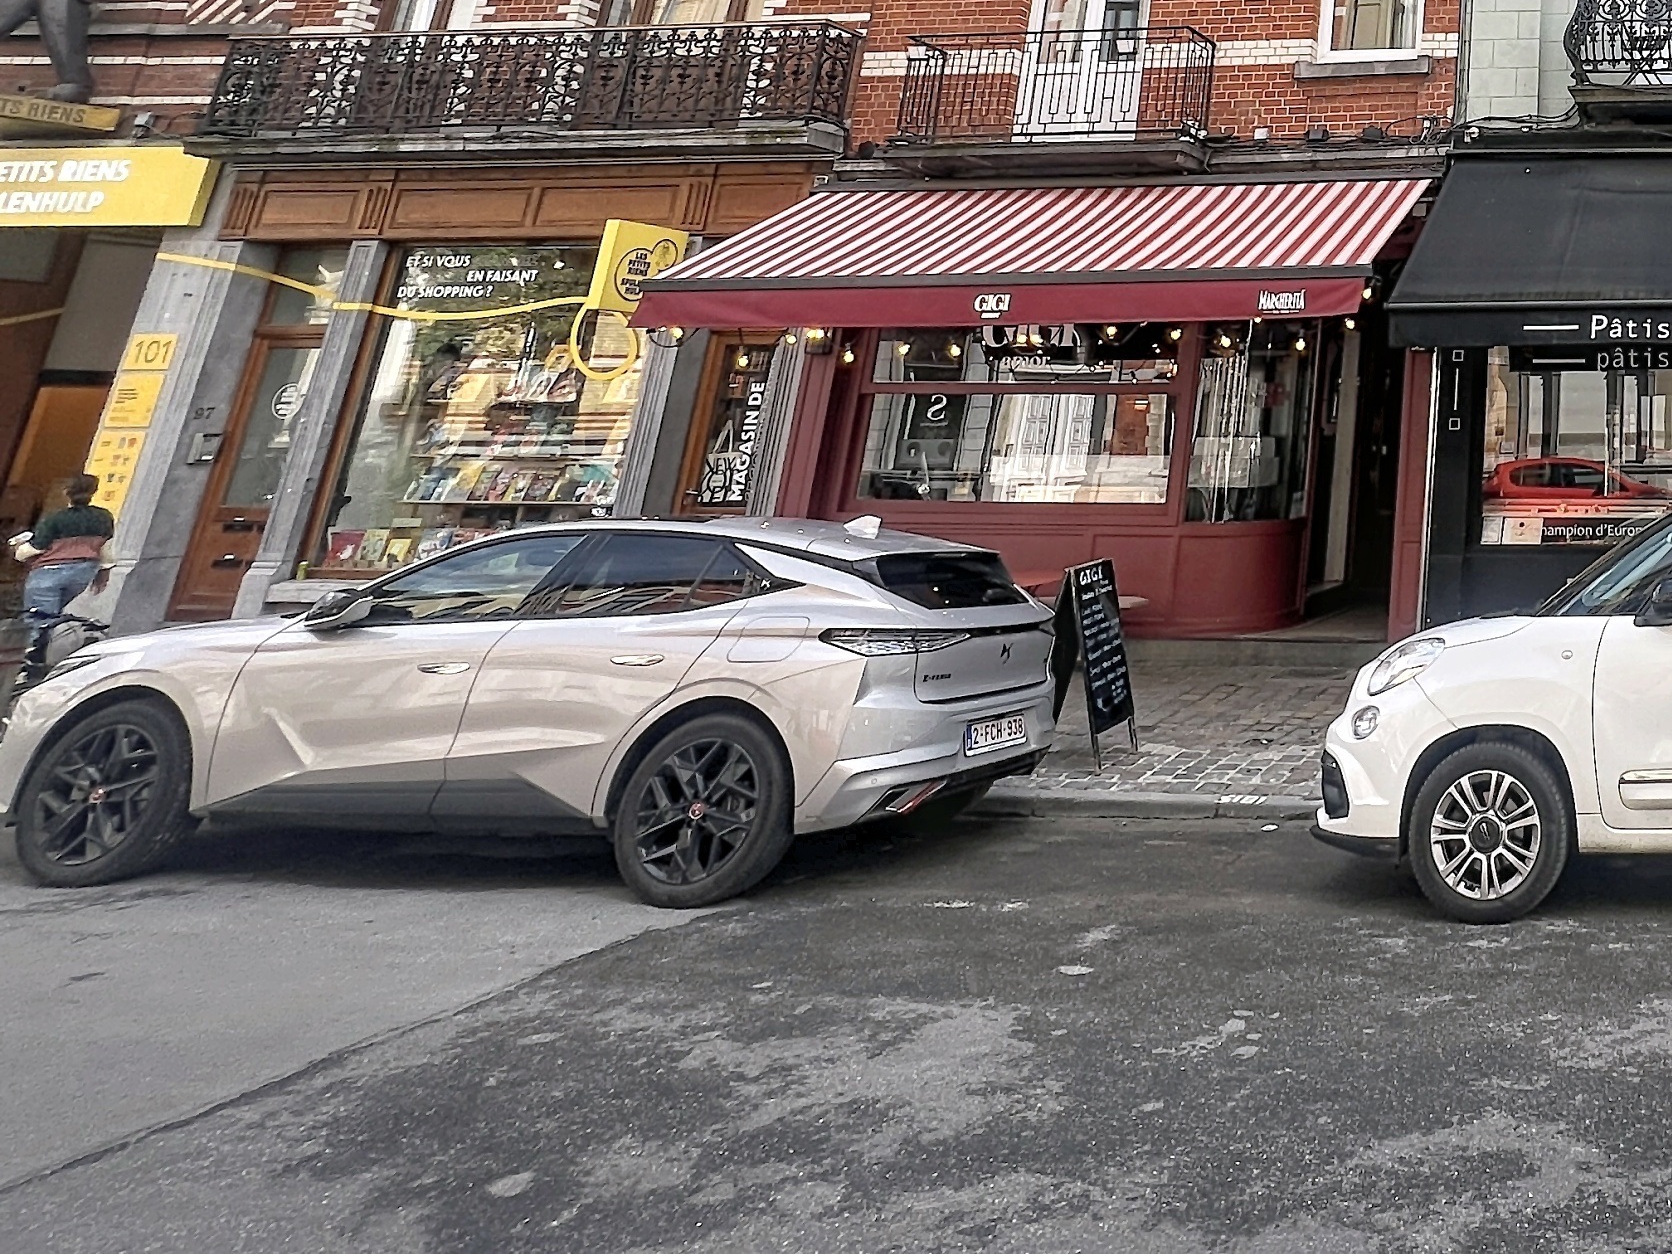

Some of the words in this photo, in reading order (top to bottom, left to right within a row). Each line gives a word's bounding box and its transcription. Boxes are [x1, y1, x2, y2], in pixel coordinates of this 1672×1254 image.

[28, 101, 87, 124] RIENS
[0, 160, 57, 183] ETITS
[57, 159, 132, 182] RIENS
[0, 191, 105, 213] LENHULP
[406, 256, 422, 267] ET
[422, 256, 434, 267] SI
[436, 255, 471, 267] VOUS
[466, 270, 485, 282] EN
[486, 269, 539, 282] FAISANT
[397, 286, 416, 298] DU
[418, 286, 484, 298] SHOPPING
[974, 294, 1011, 312] GIGI
[135, 339, 173, 364] 101
[726, 410, 760, 502] MAGASIN
[748, 382, 766, 406] DE
[1079, 565, 1104, 586] GIGI
[972, 717, 1025, 745] 2-FCH-938
